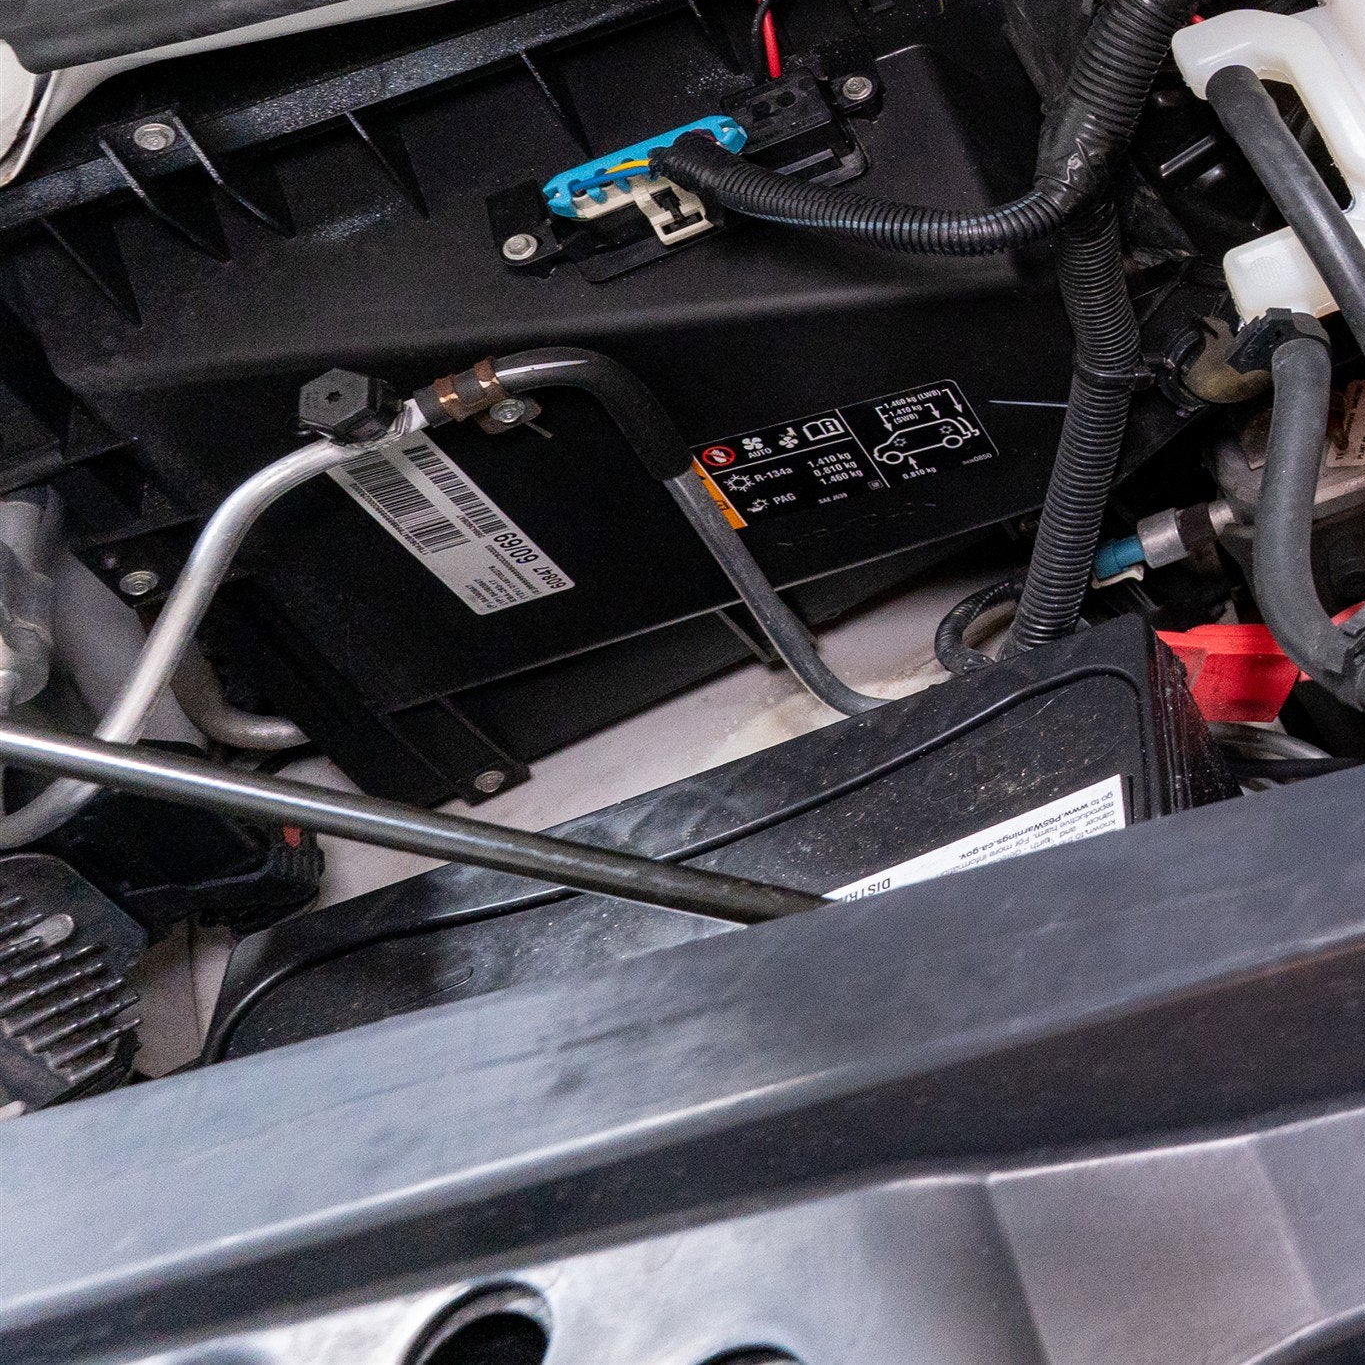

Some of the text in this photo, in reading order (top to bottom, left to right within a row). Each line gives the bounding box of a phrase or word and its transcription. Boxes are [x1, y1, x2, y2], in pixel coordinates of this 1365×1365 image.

[883, 398, 906, 408] 1.460
[917, 389, 941, 400] (LWB)
[888, 406, 911, 417] 1.410
[893, 412, 919, 424] (SWB)
[748, 447, 772, 458] AUTO
[807, 452, 851, 467] 1.410 kg
[753, 467, 793, 482] R-134a
[813, 463, 843, 476] 0.810
[902, 468, 925, 479] 0.810
[819, 469, 863, 485] 1.460 kg
[772, 492, 796, 504] PAG
[493, 532, 539, 564] 60/69
[532, 566, 566, 589] 60847
[1102, 791, 1114, 801] go
[1090, 798, 1100, 807] to
[1059, 801, 1114, 828] reproductive
[1085, 810, 1115, 827] cancer
[1059, 826, 1076, 837] and
[1015, 837, 1030, 847] For
[989, 844, 1012, 856] more
